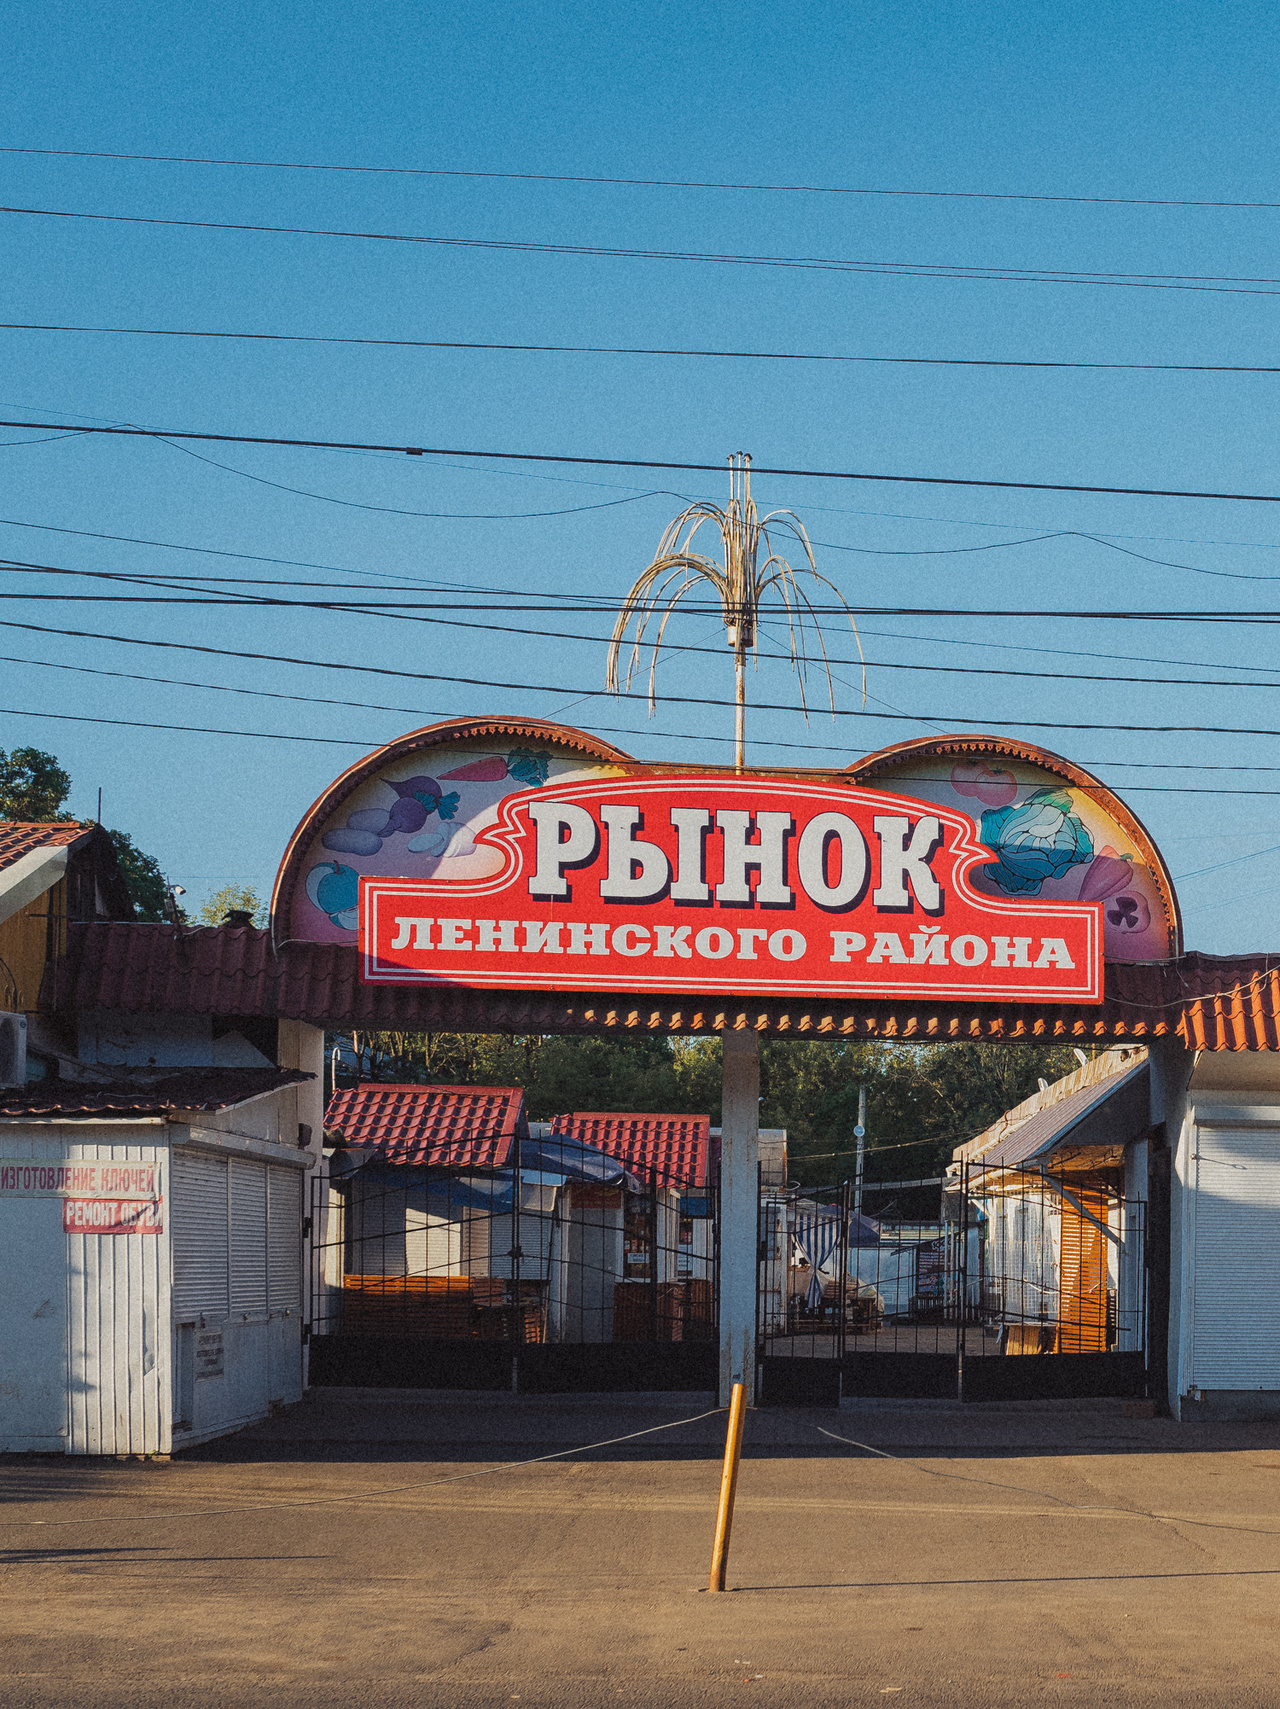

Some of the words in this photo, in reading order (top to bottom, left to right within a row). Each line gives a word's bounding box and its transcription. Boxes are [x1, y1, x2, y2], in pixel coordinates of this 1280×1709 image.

[528, 801, 943, 915] РЫНОК
[391, 915, 807, 961] ЛЕНИНСКОГО
[829, 925, 1076, 969] РАЙОНА
[1, 1166, 96, 1190] ИЗГОТОВЛЕНИЕ
[101, 1165, 154, 1192] КЛЮЧЕЙ
[66, 1201, 118, 1226] РЕМОНТ
[121, 1202, 163, 1227] ОБУВИ
